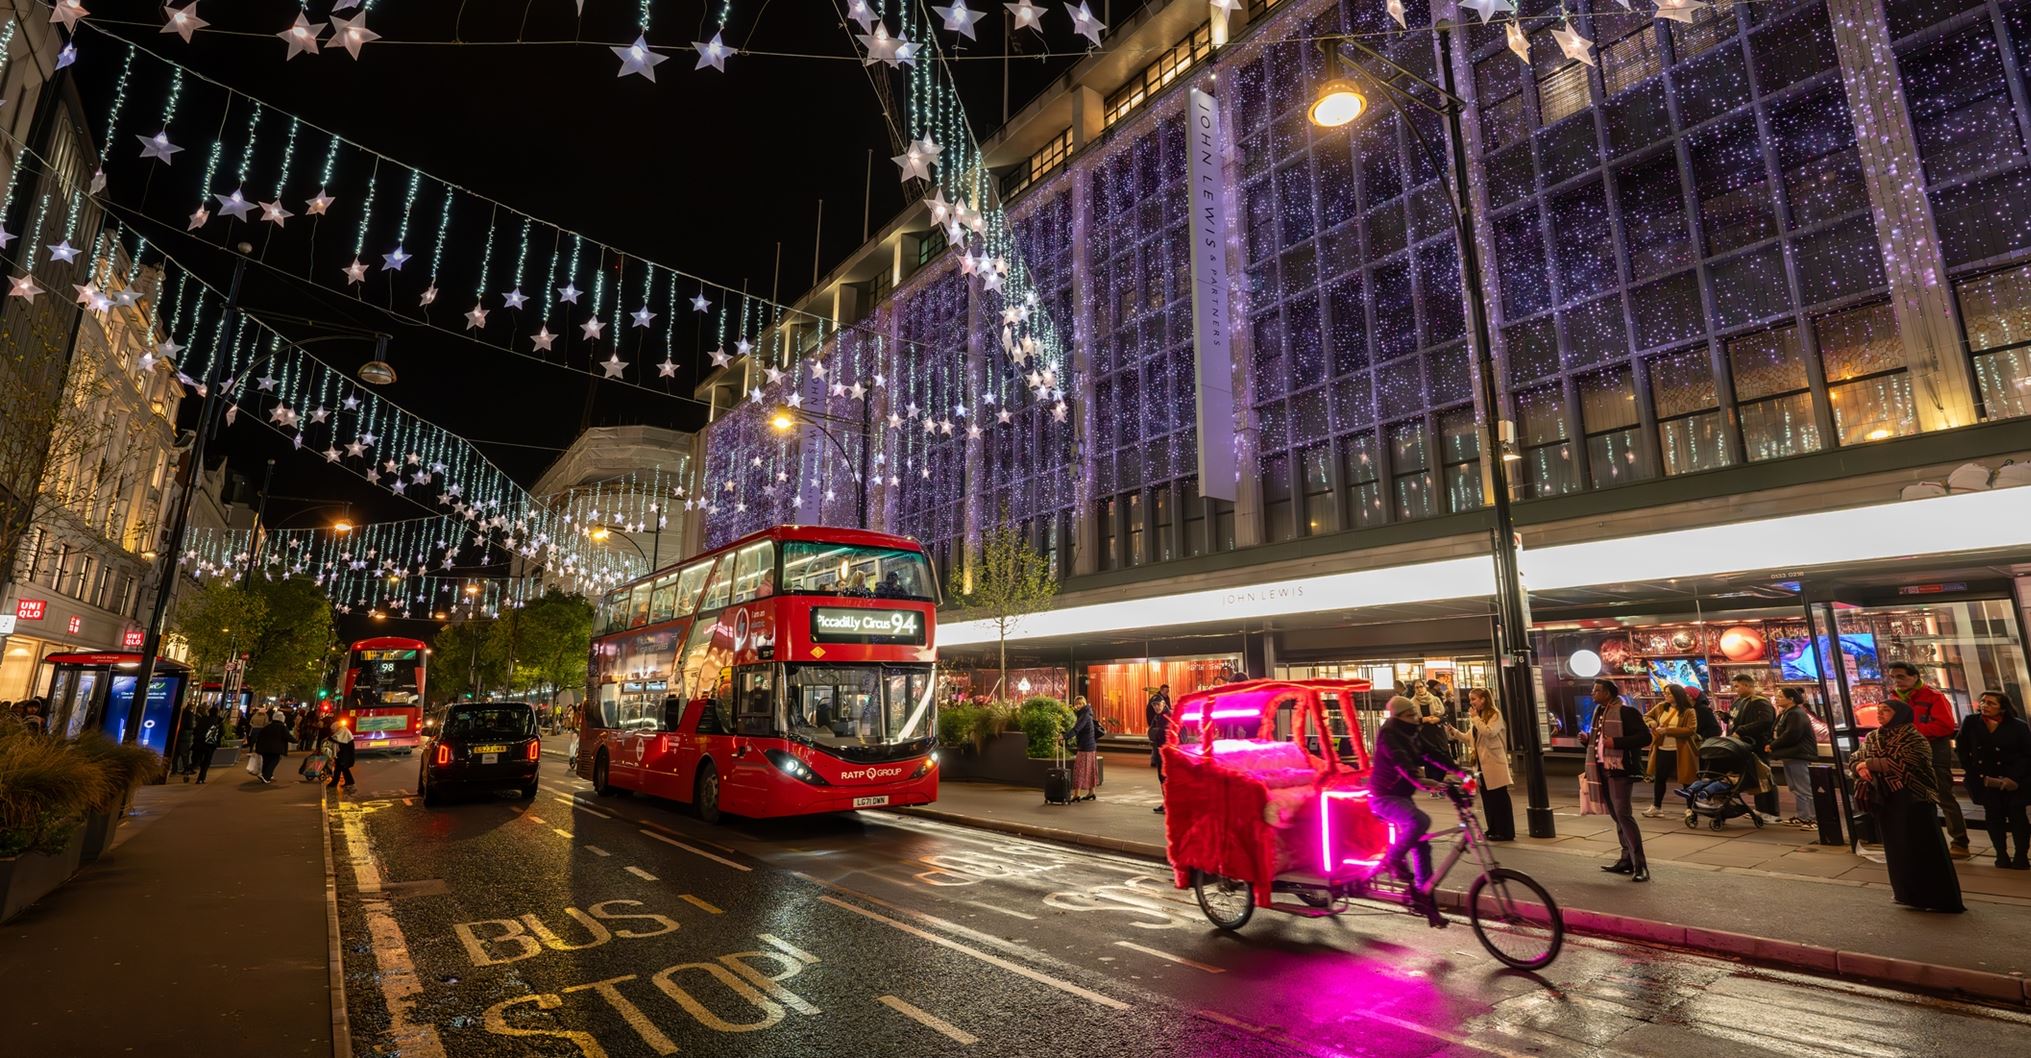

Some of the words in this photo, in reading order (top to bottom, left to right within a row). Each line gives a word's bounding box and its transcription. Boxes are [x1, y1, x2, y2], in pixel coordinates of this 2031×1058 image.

[1199, 104, 1212, 165] JOHN
[1203, 175, 1216, 248] LEWIS
[1210, 254, 1217, 262] &
[1210, 268, 1221, 347] PARTNERS
[1223, 593, 1255, 606] JOHN
[1261, 586, 1304, 600] LEWIS
[18, 610, 41, 618] QLO
[817, 615, 860, 631] Piccadilly
[863, 617, 891, 629] Circus
[891, 613, 917, 634] 94
[381, 663, 394, 673] 98
[841, 770, 865, 779] RATP
[877, 768, 902, 777] GROUP
[453, 899, 681, 967] BUS
[483, 932, 823, 1058] STOP
